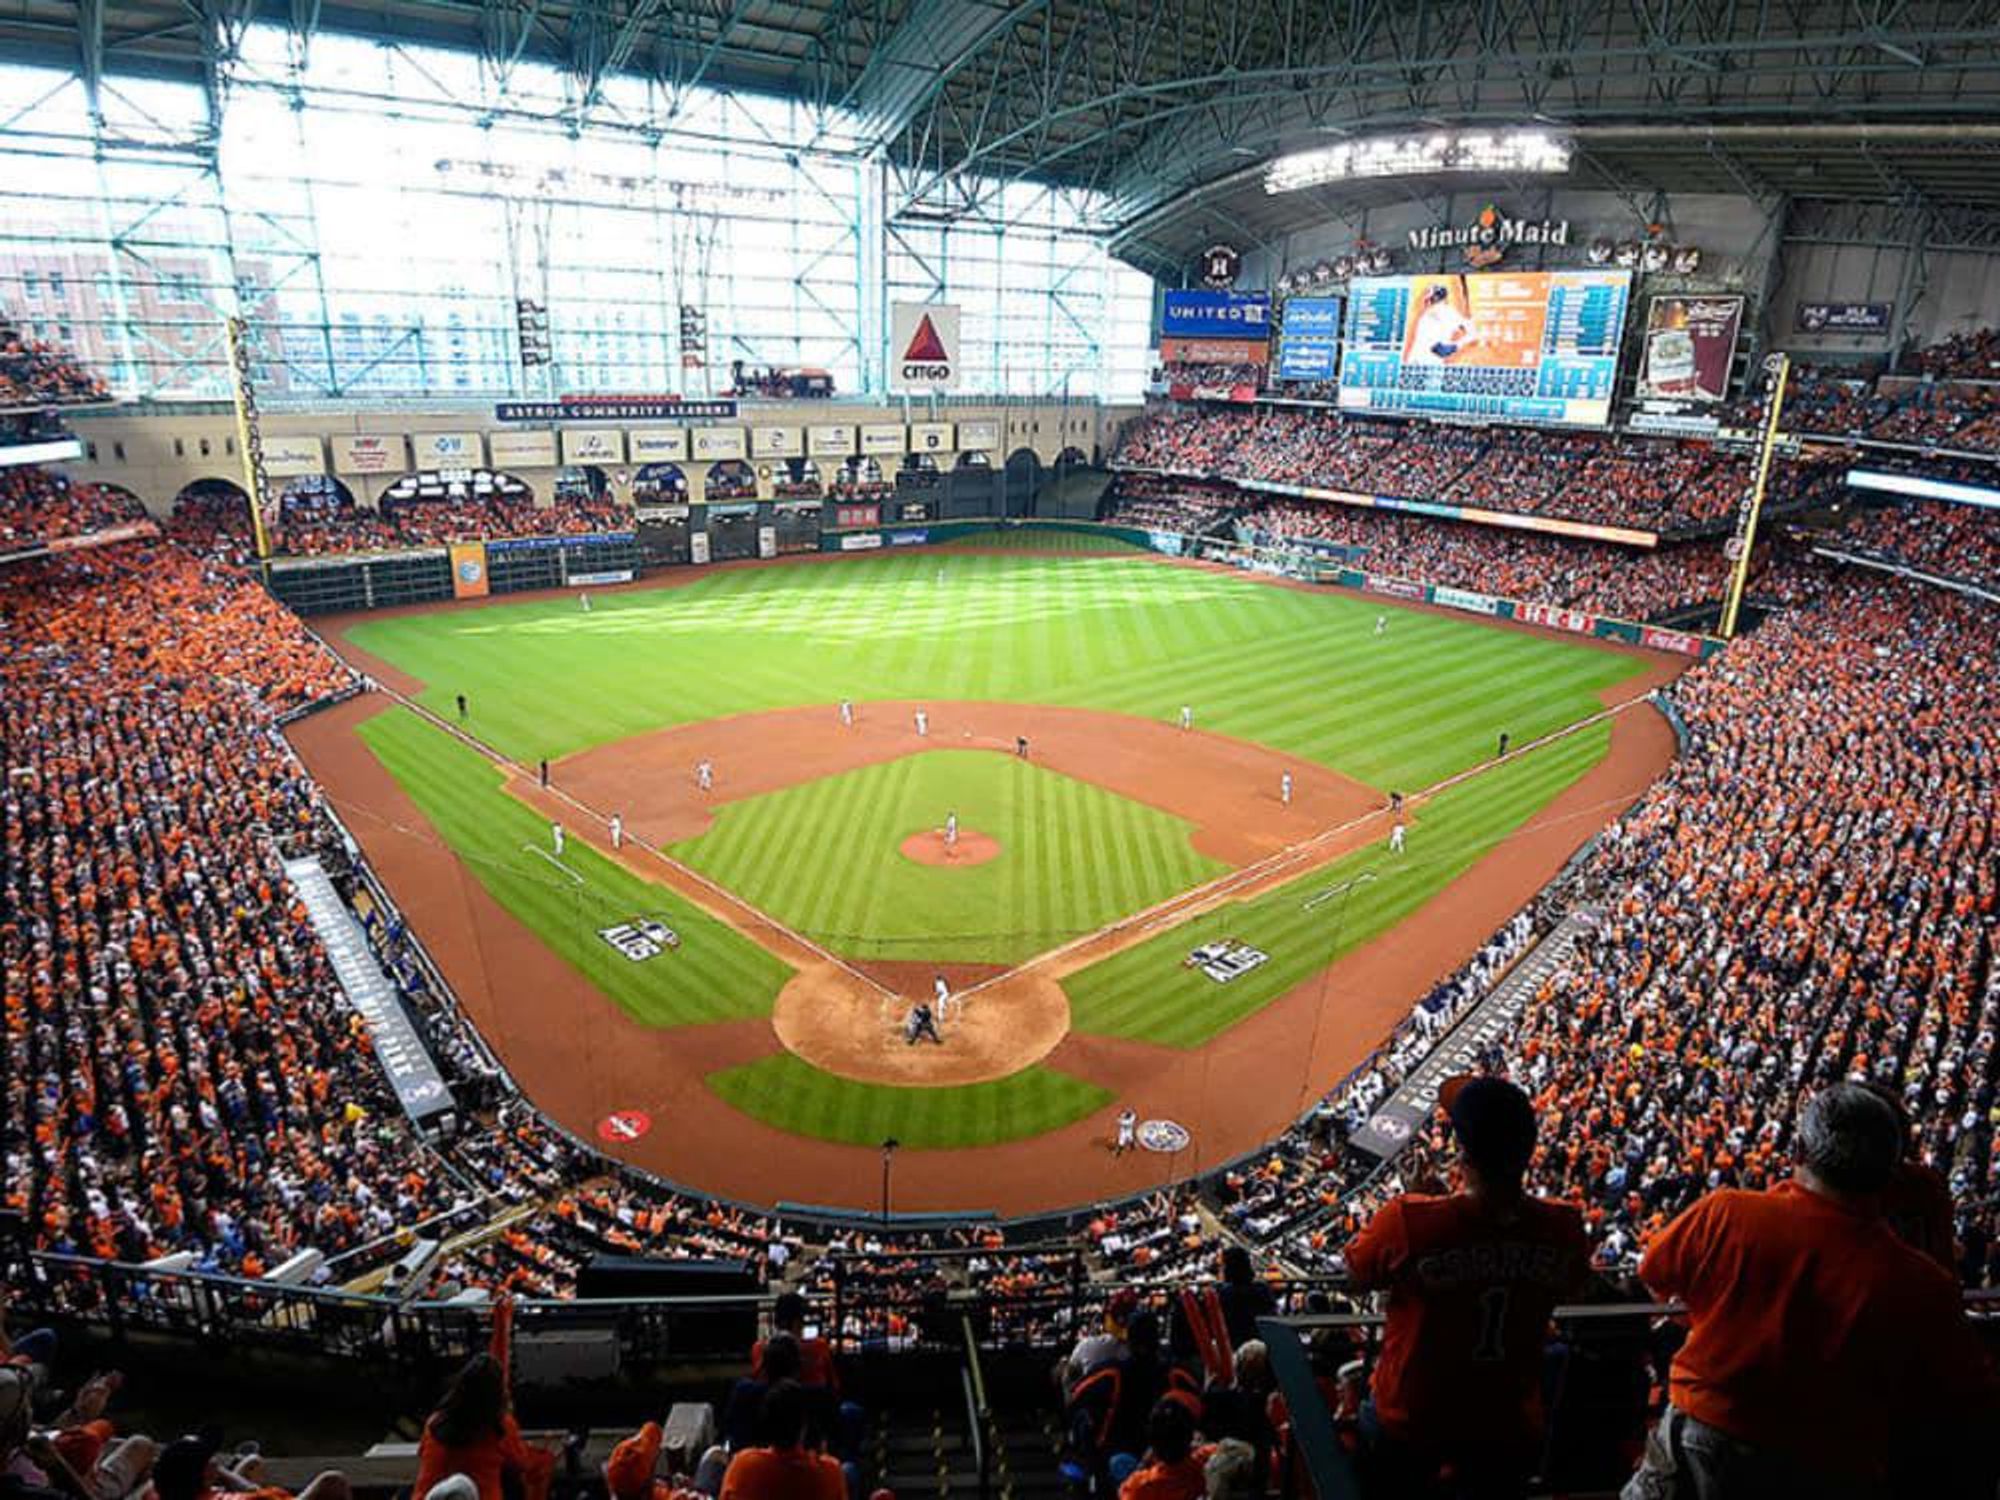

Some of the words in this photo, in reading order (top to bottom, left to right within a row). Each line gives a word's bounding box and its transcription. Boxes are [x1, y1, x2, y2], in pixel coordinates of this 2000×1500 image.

[1408, 225, 1495, 249] Minute
[1500, 219, 1568, 245] Maid
[1170, 305, 1241, 321] UNITED
[902, 364, 951, 380] CITGO
[506, 407, 565, 418] ASTROS
[573, 406, 663, 417] COMMUNITY
[1470, 1286, 1506, 1361] 1
